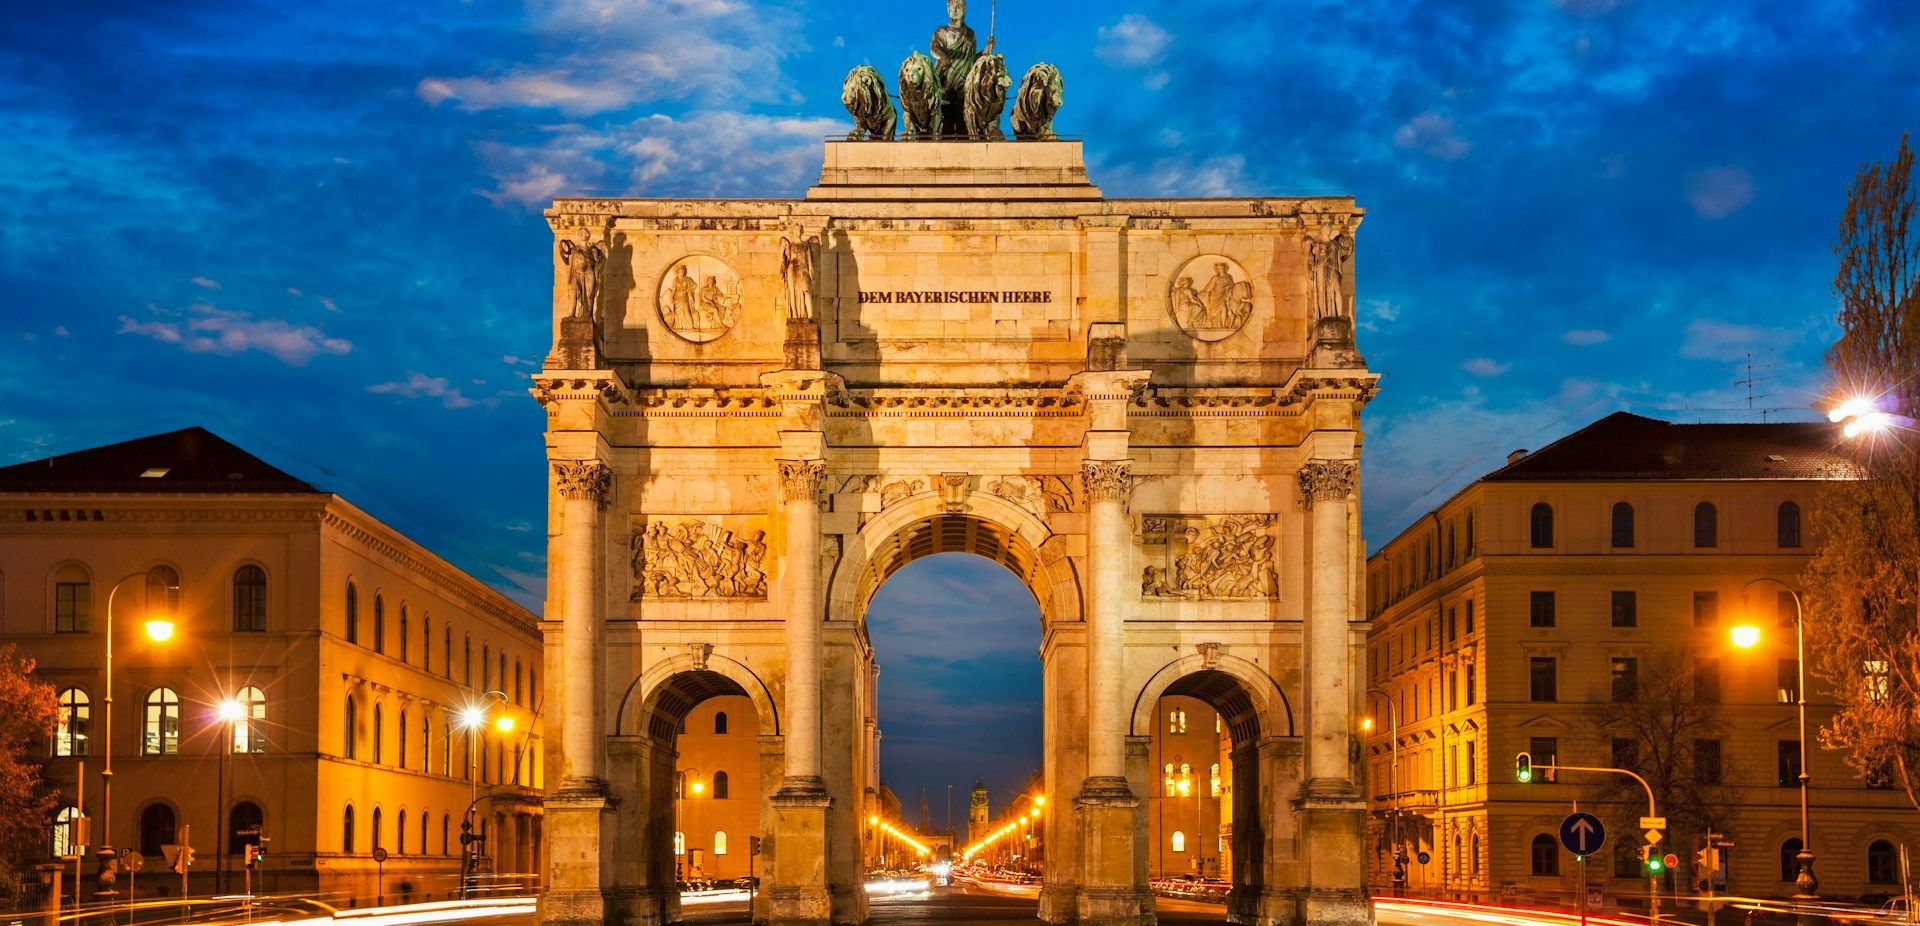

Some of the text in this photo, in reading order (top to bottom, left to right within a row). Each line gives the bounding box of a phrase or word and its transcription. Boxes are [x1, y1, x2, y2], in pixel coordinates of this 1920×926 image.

[857, 291, 1052, 304] DEM BAYERISCHEN HEERE
